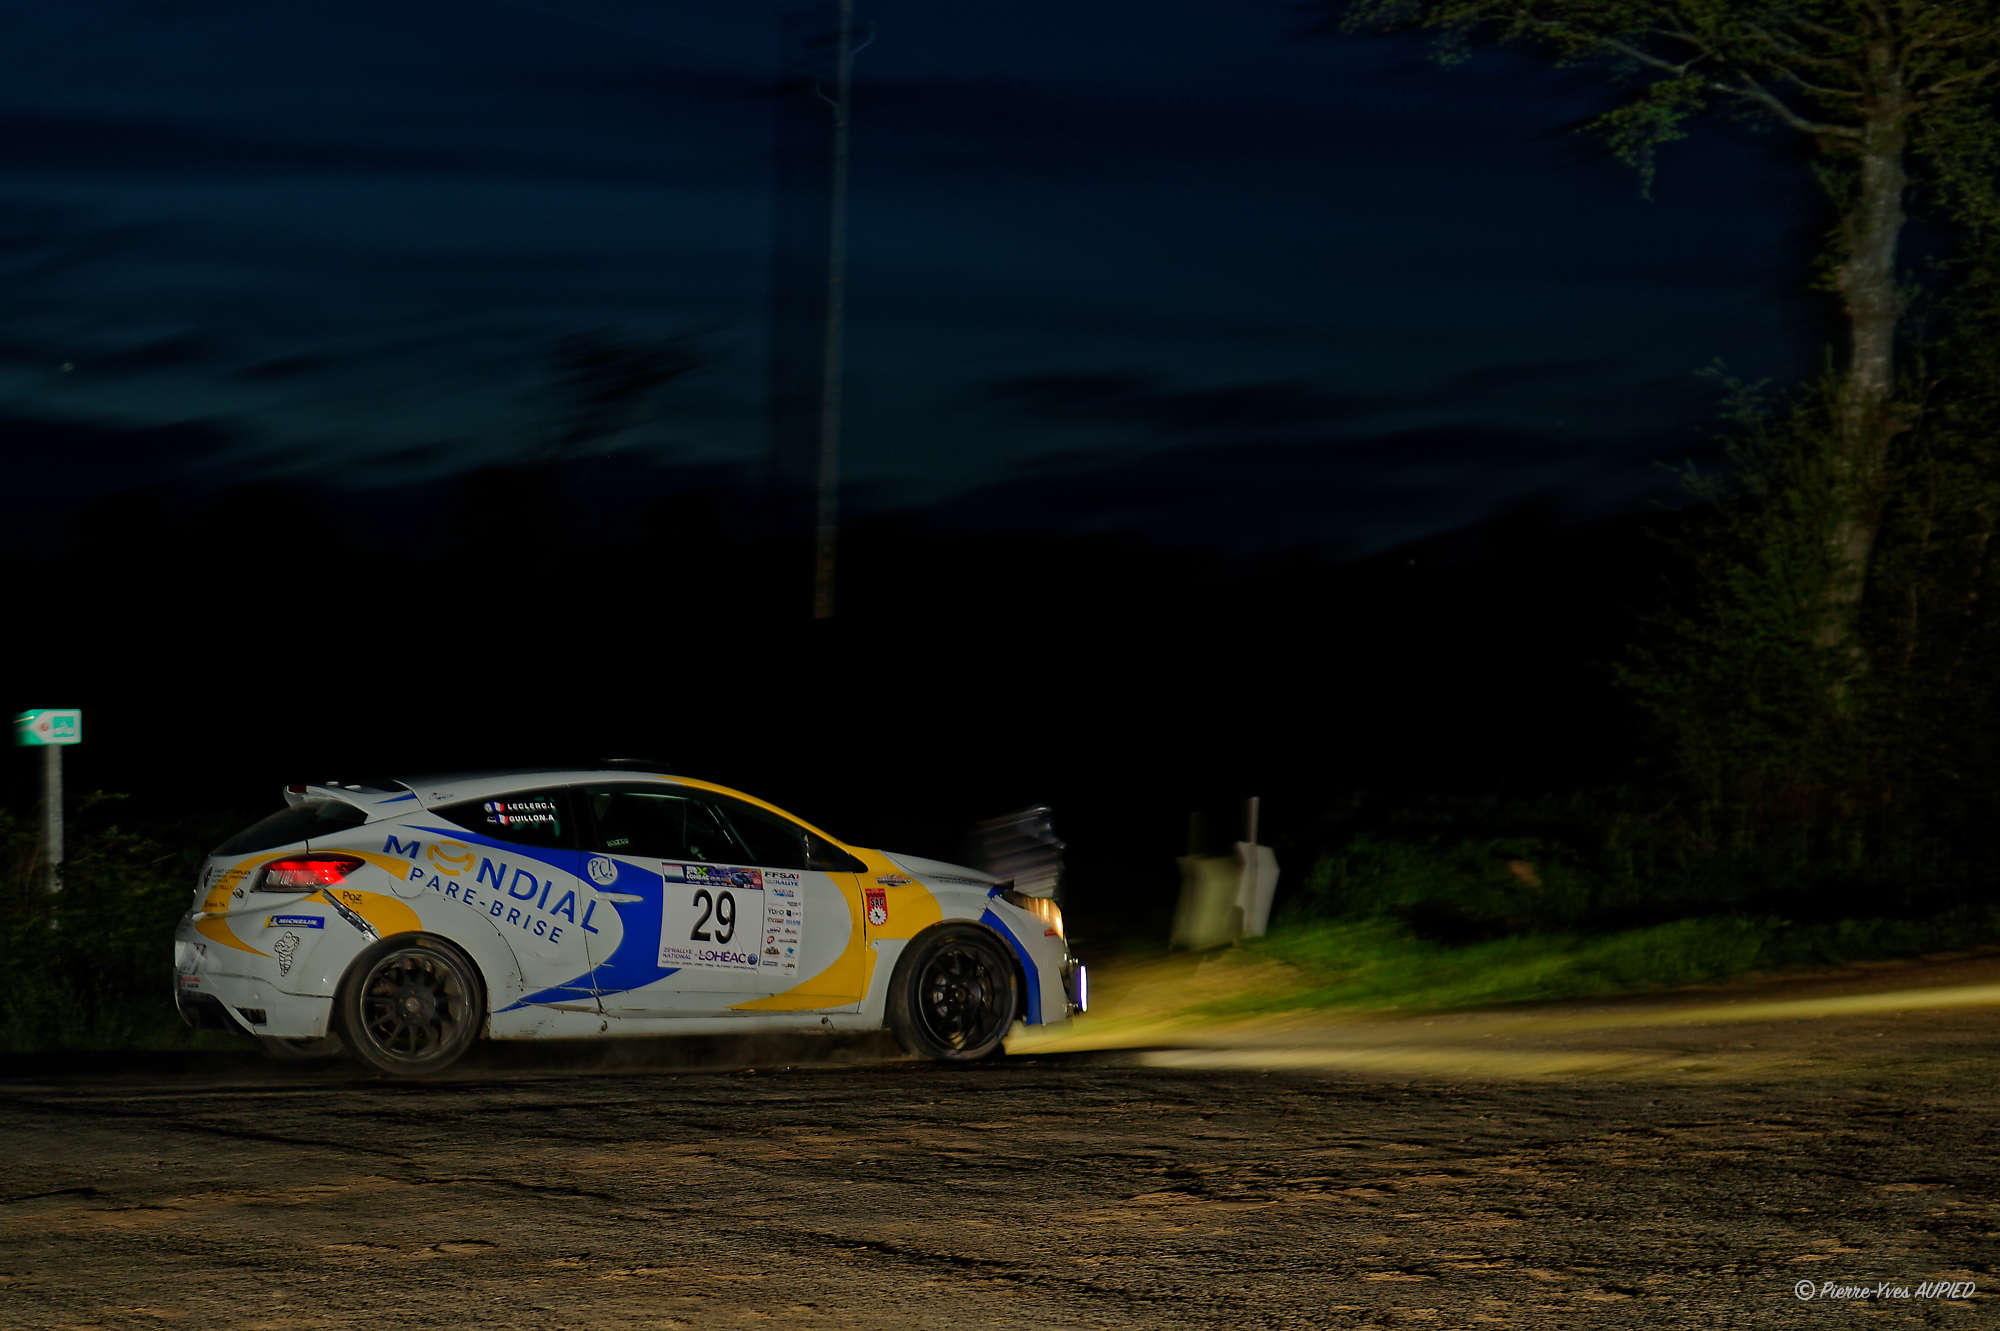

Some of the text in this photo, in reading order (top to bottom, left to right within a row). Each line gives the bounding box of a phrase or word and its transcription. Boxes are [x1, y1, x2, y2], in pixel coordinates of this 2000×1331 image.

[382, 834, 601, 935] MONDIAL
[409, 867, 563, 944] PARE-BRISE
[690, 888, 736, 944] 29
